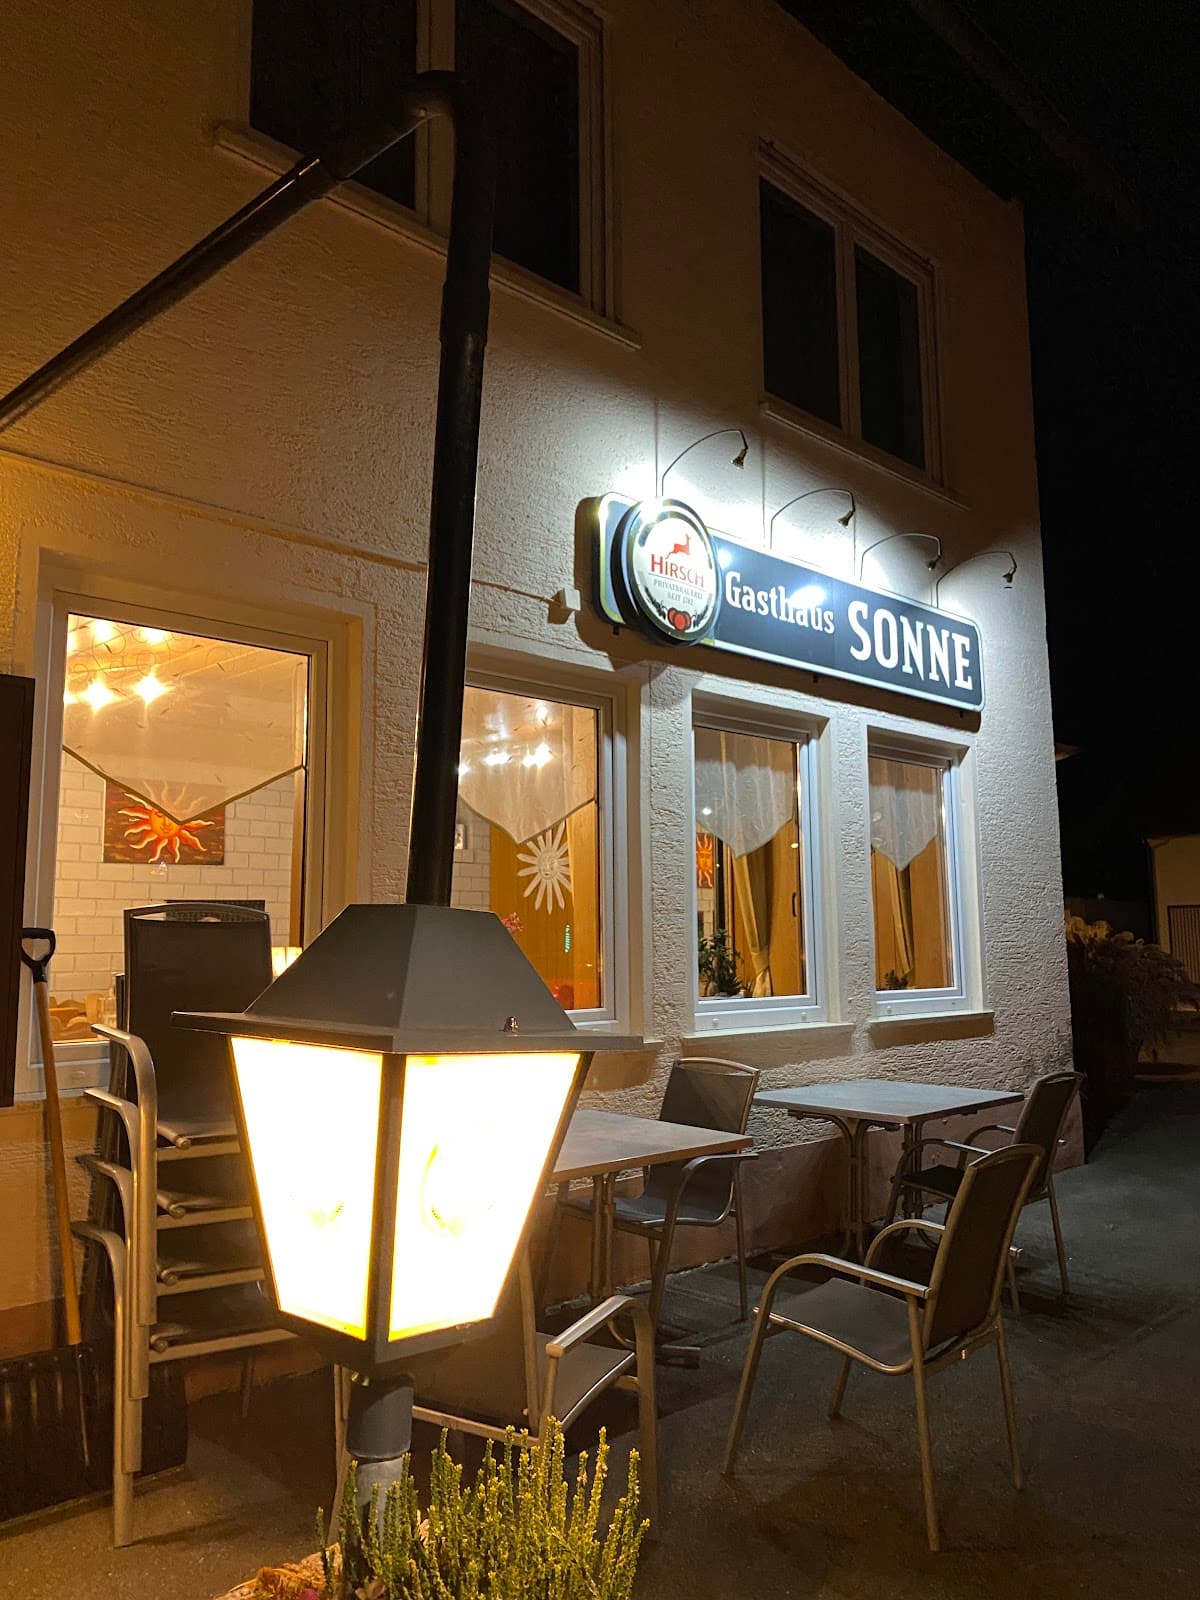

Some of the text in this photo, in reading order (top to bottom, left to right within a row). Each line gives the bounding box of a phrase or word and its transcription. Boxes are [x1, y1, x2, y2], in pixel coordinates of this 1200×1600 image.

[651, 553, 704, 588] HIRSCH
[725, 571, 973, 691] Gasthaus SONNE
